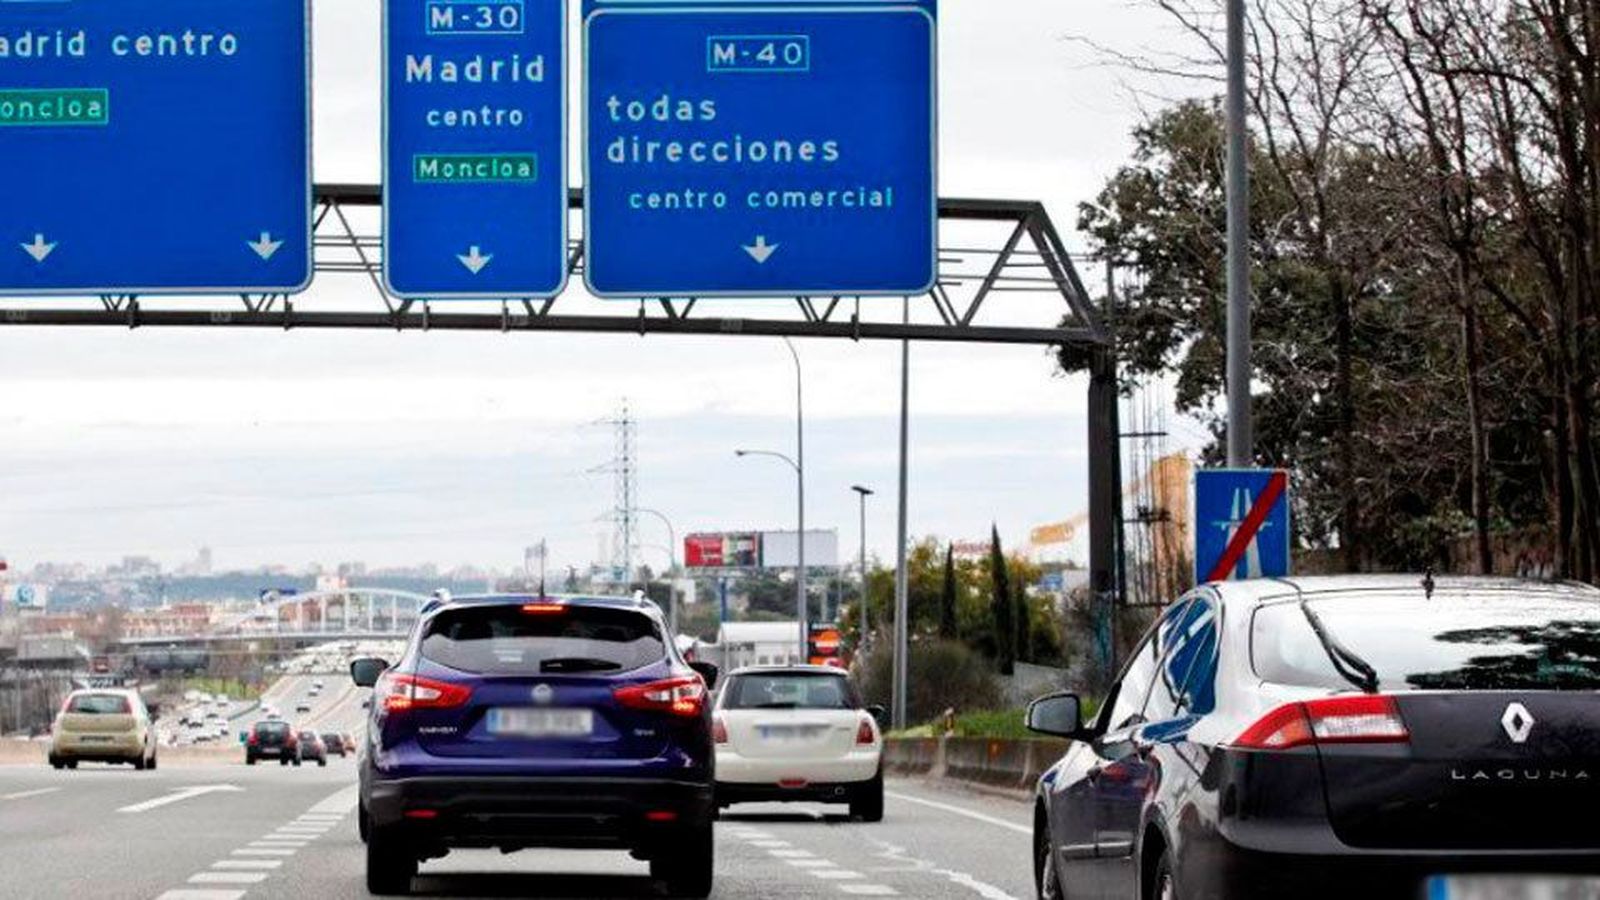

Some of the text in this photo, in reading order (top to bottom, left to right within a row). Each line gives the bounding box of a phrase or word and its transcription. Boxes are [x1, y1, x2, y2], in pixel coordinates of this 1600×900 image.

[431, 3, 519, 30] M-30
[112, 31, 237, 57] centro
[712, 42, 803, 66] M-40
[405, 54, 545, 83] Madrid
[426, 105, 524, 127] centro
[606, 95, 717, 121] todas
[607, 136, 840, 163] direcciones
[419, 157, 531, 179] Moncloa
[629, 187, 893, 209] centro comercial
[1451, 768, 1590, 780] LAGUNA
